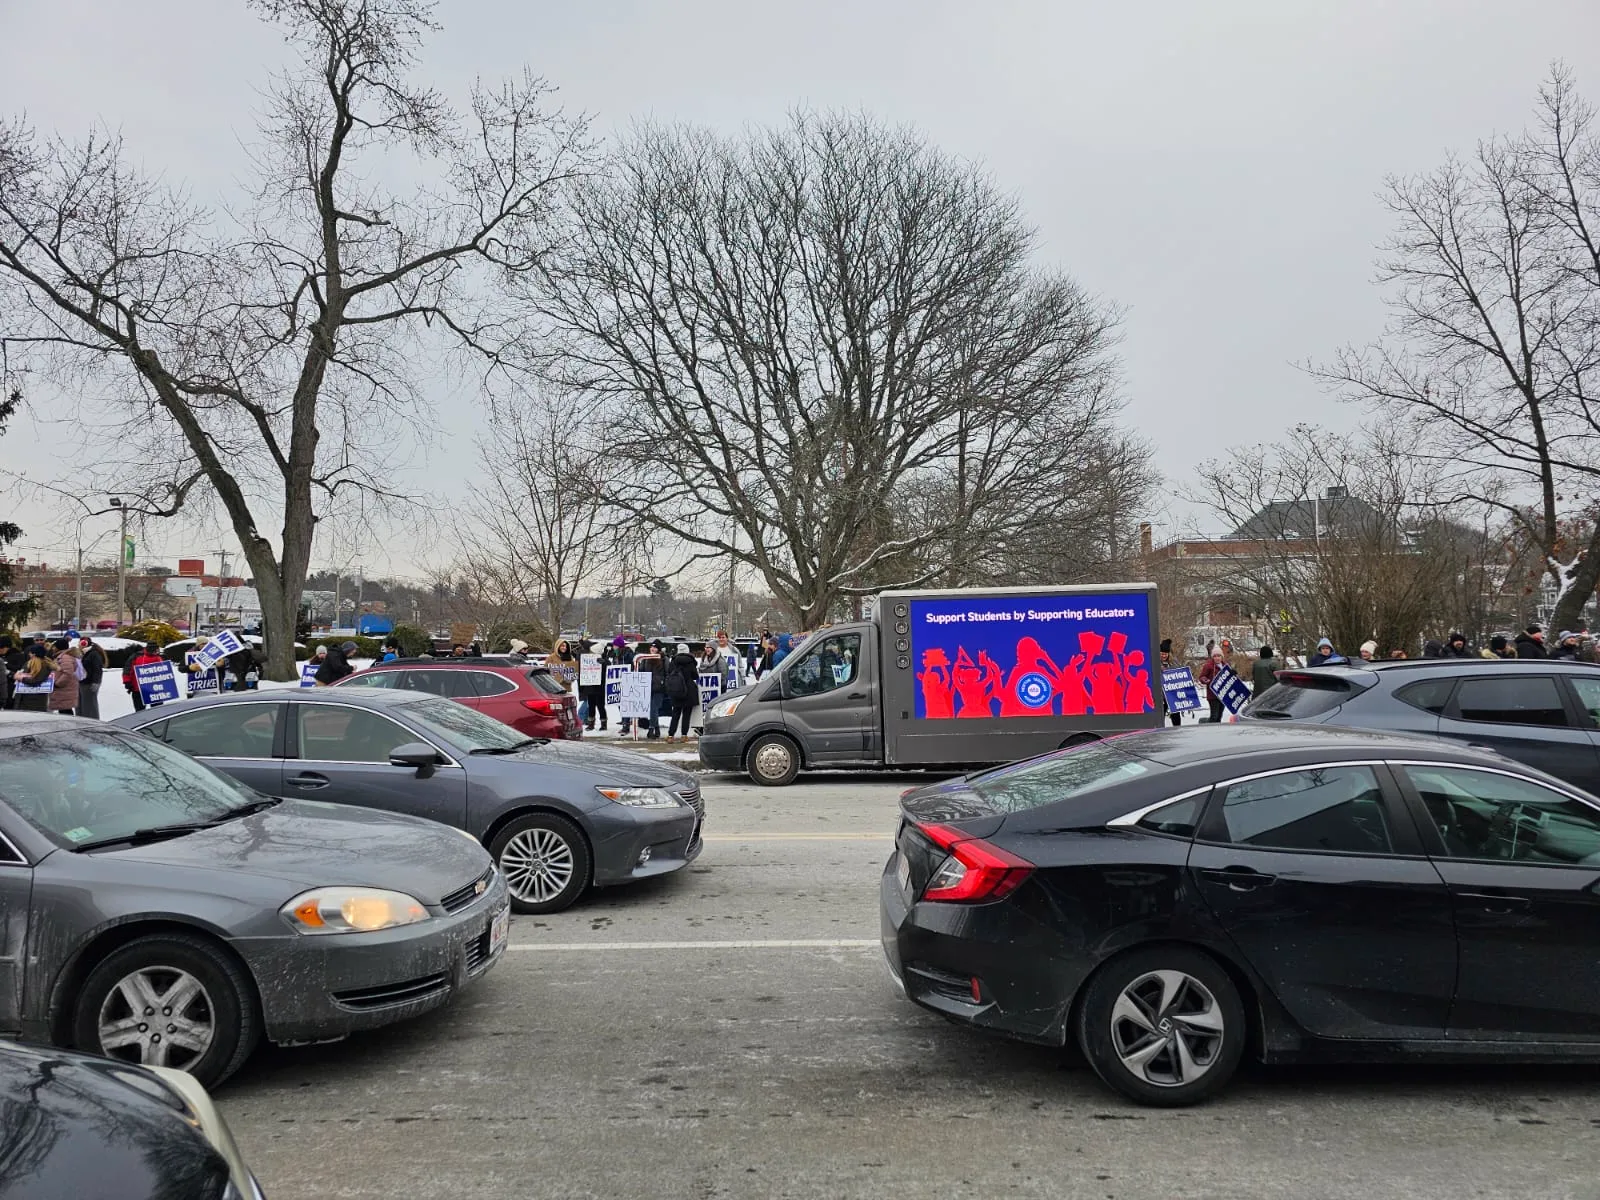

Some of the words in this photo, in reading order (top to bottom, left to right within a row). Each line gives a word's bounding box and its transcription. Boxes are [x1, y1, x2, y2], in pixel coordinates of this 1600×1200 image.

[926, 613, 966, 624] Support
[967, 611, 1011, 622] Students
[1013, 611, 1025, 622] by
[1027, 609, 1083, 621] Supporting
[1085, 607, 1135, 618] Educators
[217, 632, 240, 652] NTA
[139, 664, 169, 675] Newton
[194, 671, 208, 680] ON
[138, 672, 174, 685] Educators
[623, 672, 648, 684] THE
[696, 675, 719, 687] NTA
[1163, 671, 1188, 681] Newton
[188, 679, 217, 690] STRIKE
[1163, 680, 1194, 692] Educators
[149, 691, 172, 702] Strike
[622, 685, 649, 700] LAST
[1174, 700, 1194, 710] Strike
